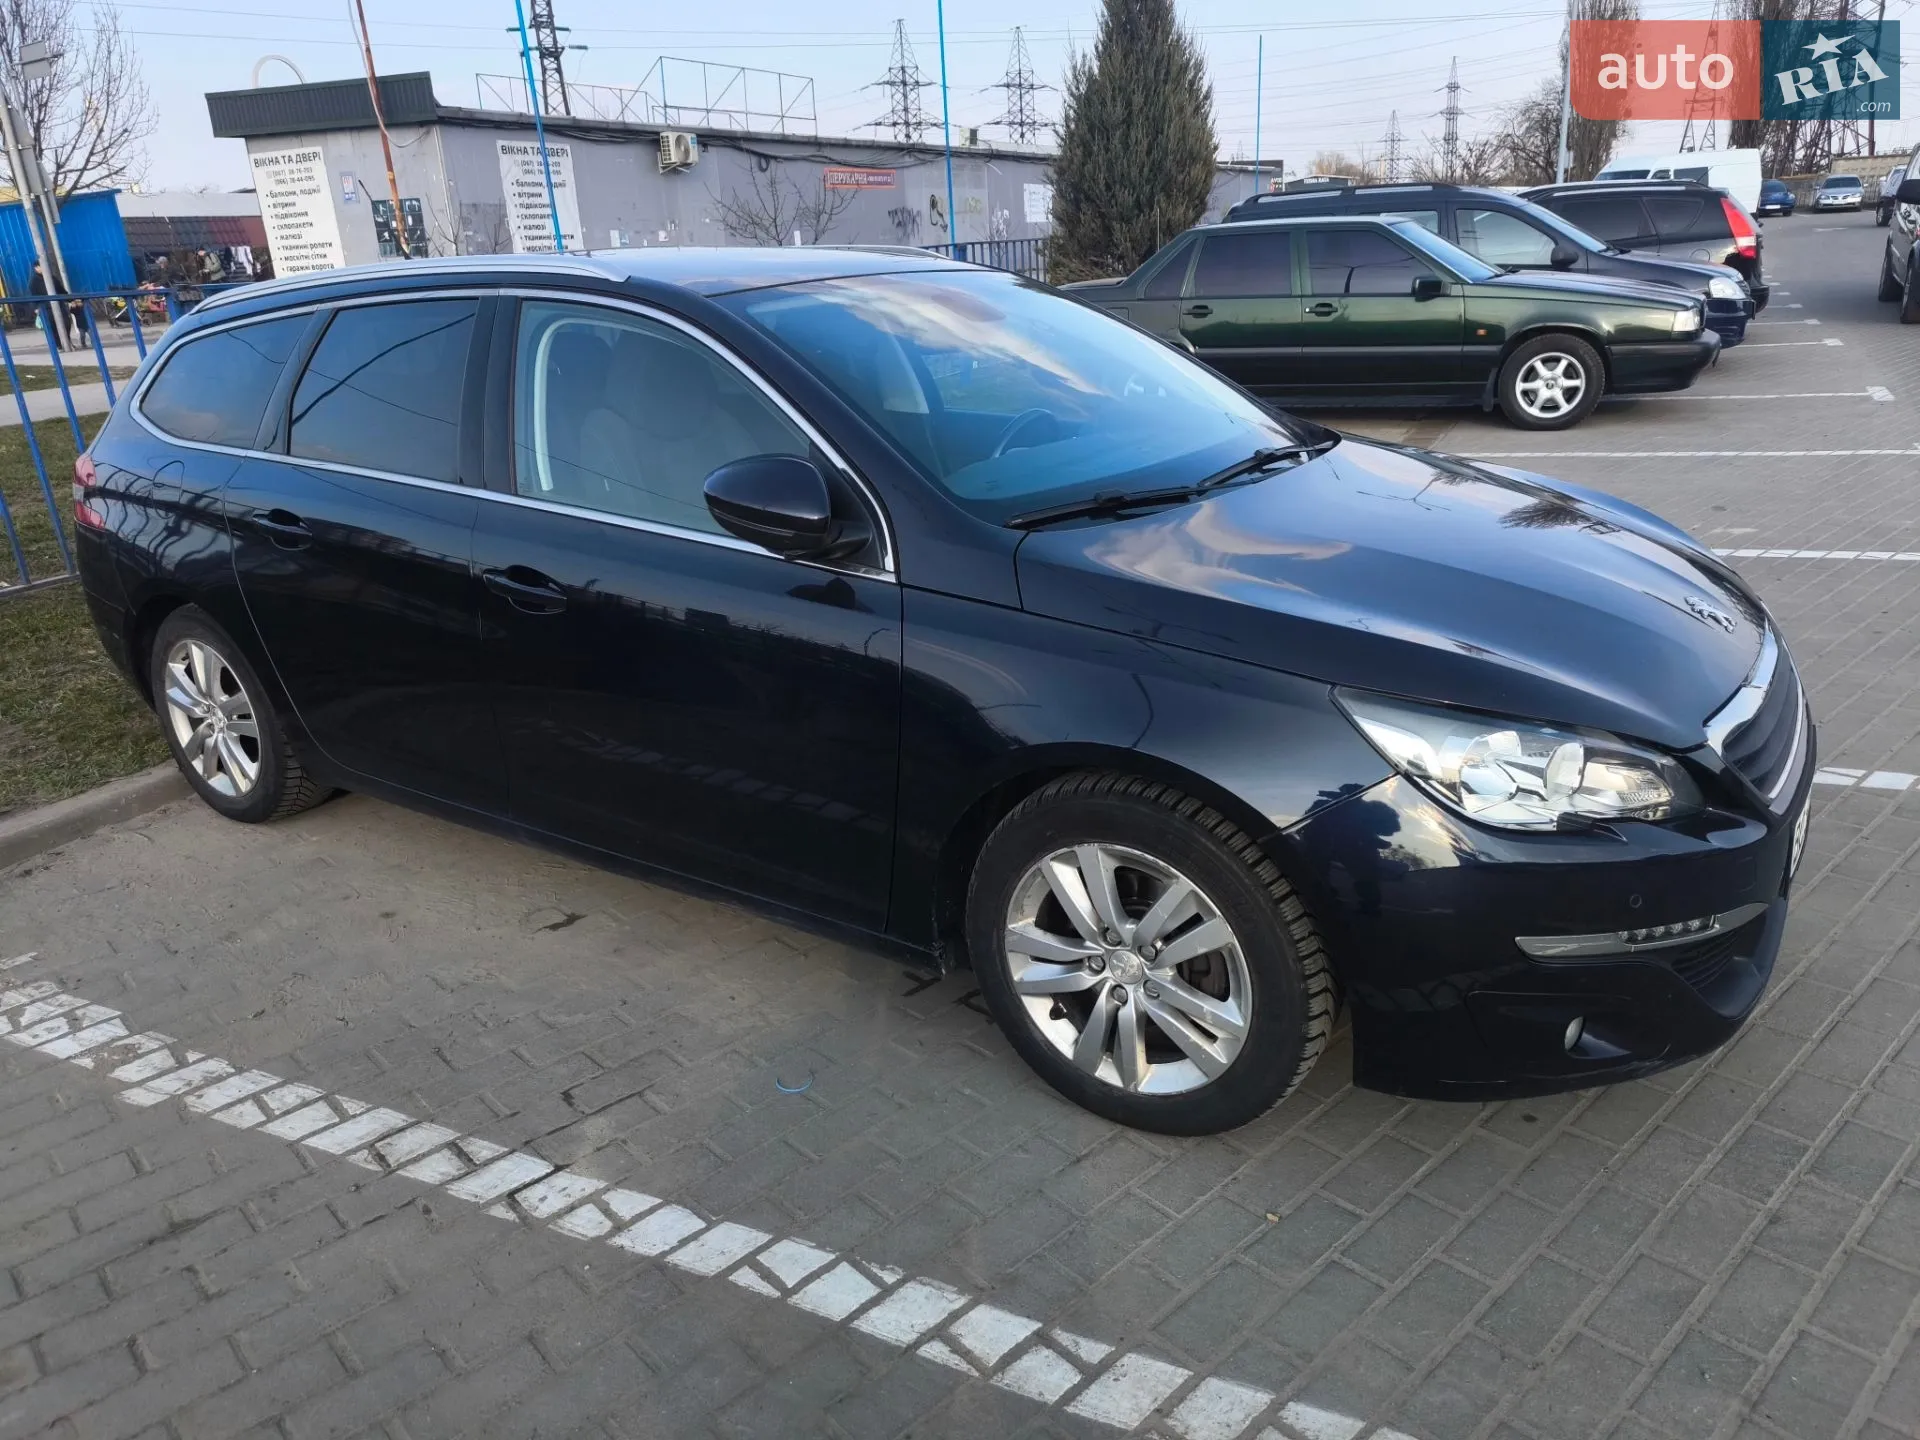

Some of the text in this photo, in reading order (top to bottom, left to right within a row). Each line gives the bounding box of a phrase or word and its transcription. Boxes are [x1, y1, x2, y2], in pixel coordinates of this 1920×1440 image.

[501, 145, 529, 156] ВІКНА
[254, 151, 322, 168] ВІКНА ТА ДВЕРІ
[517, 189, 543, 199] вітрини
[272, 200, 297, 210] вітрини
[274, 211, 309, 220] підвіконня
[276, 221, 314, 231] склопакети
[523, 222, 547, 231] жалюзі
[279, 230, 303, 240] жалюзі
[524, 233, 552, 241] тканинні
[281, 241, 333, 251] тканинні ролети
[526, 243, 552, 252] москітні
[283, 251, 328, 261] москітні сітки
[286, 262, 335, 273] гаражні ворота
